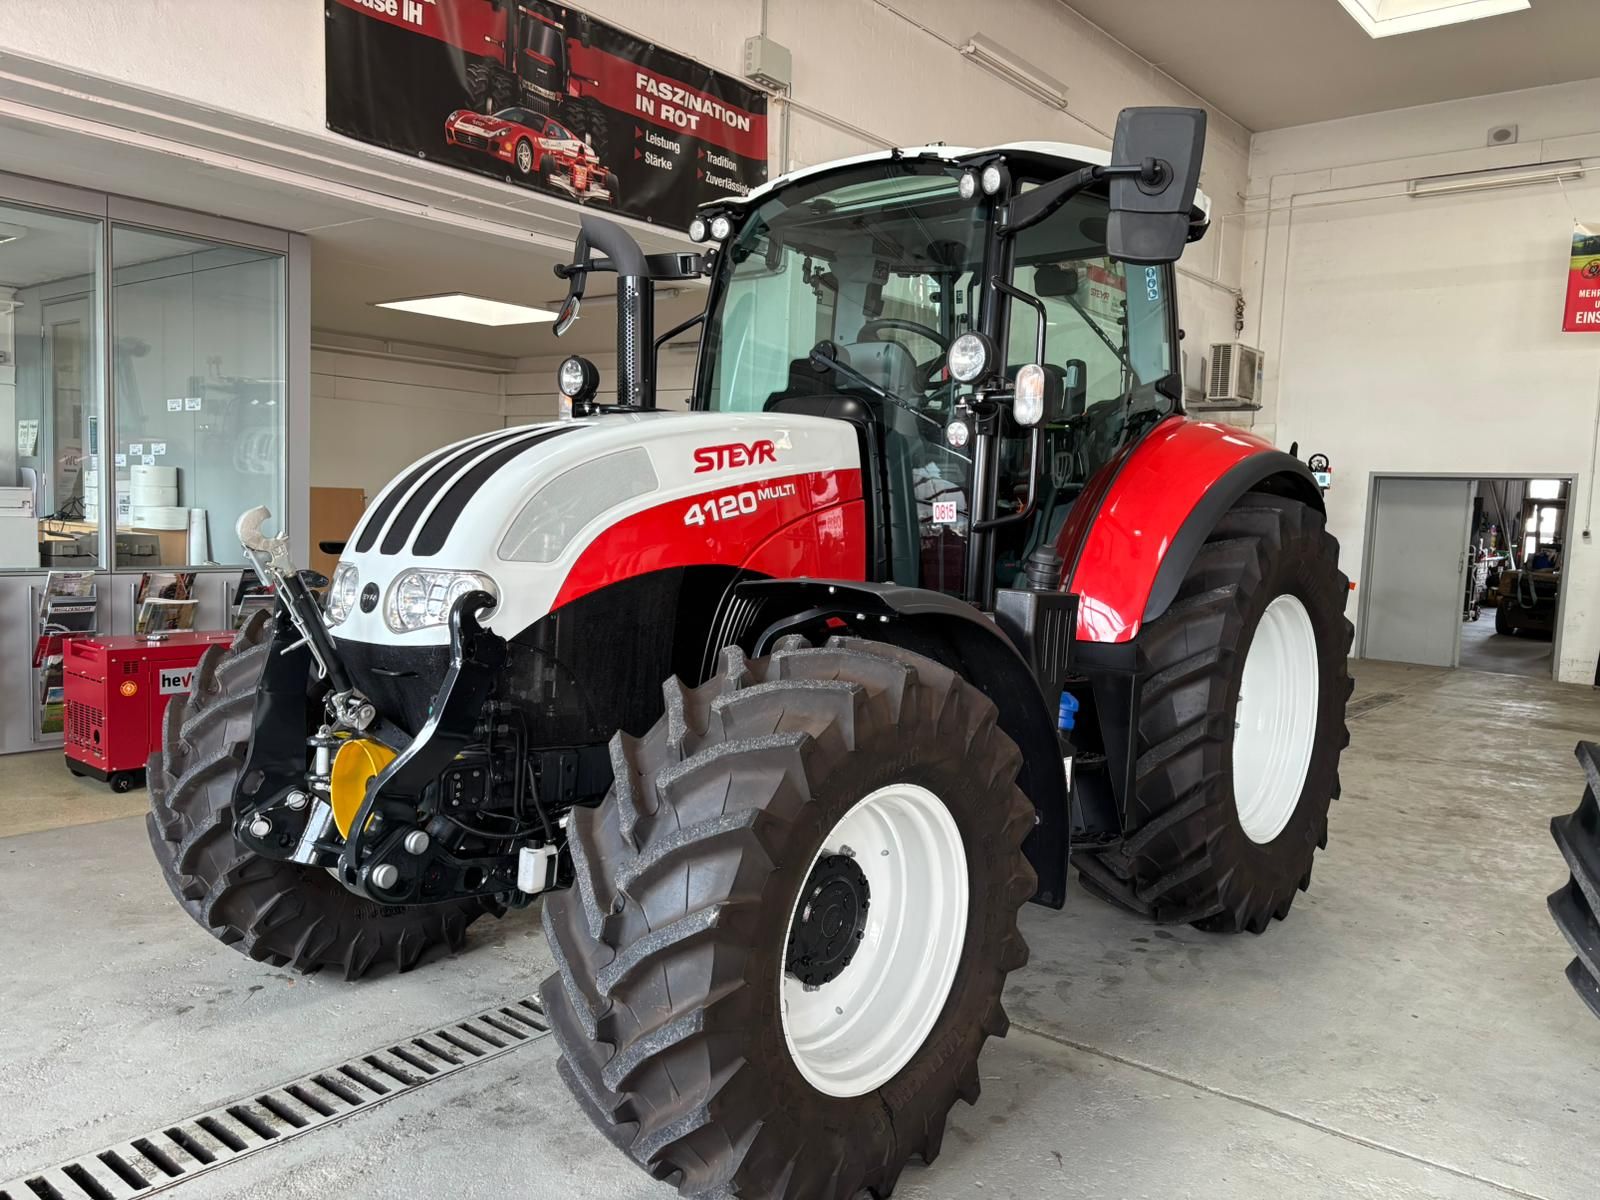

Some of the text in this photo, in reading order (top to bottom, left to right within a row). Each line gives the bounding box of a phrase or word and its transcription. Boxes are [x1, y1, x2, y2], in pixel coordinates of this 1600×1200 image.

[353, 0, 423, 25] ase IH
[635, 93, 700, 130] IN ROT
[636, 72, 750, 132] FASZINATION
[645, 130, 681, 154] Leistung
[645, 152, 673, 170] Stärke
[706, 151, 737, 172] Tradition
[705, 171, 753, 196] Zuverlässigk
[693, 439, 777, 473] STEYR
[683, 483, 796, 526] 4120 MULTI
[935, 504, 954, 520] 0815
